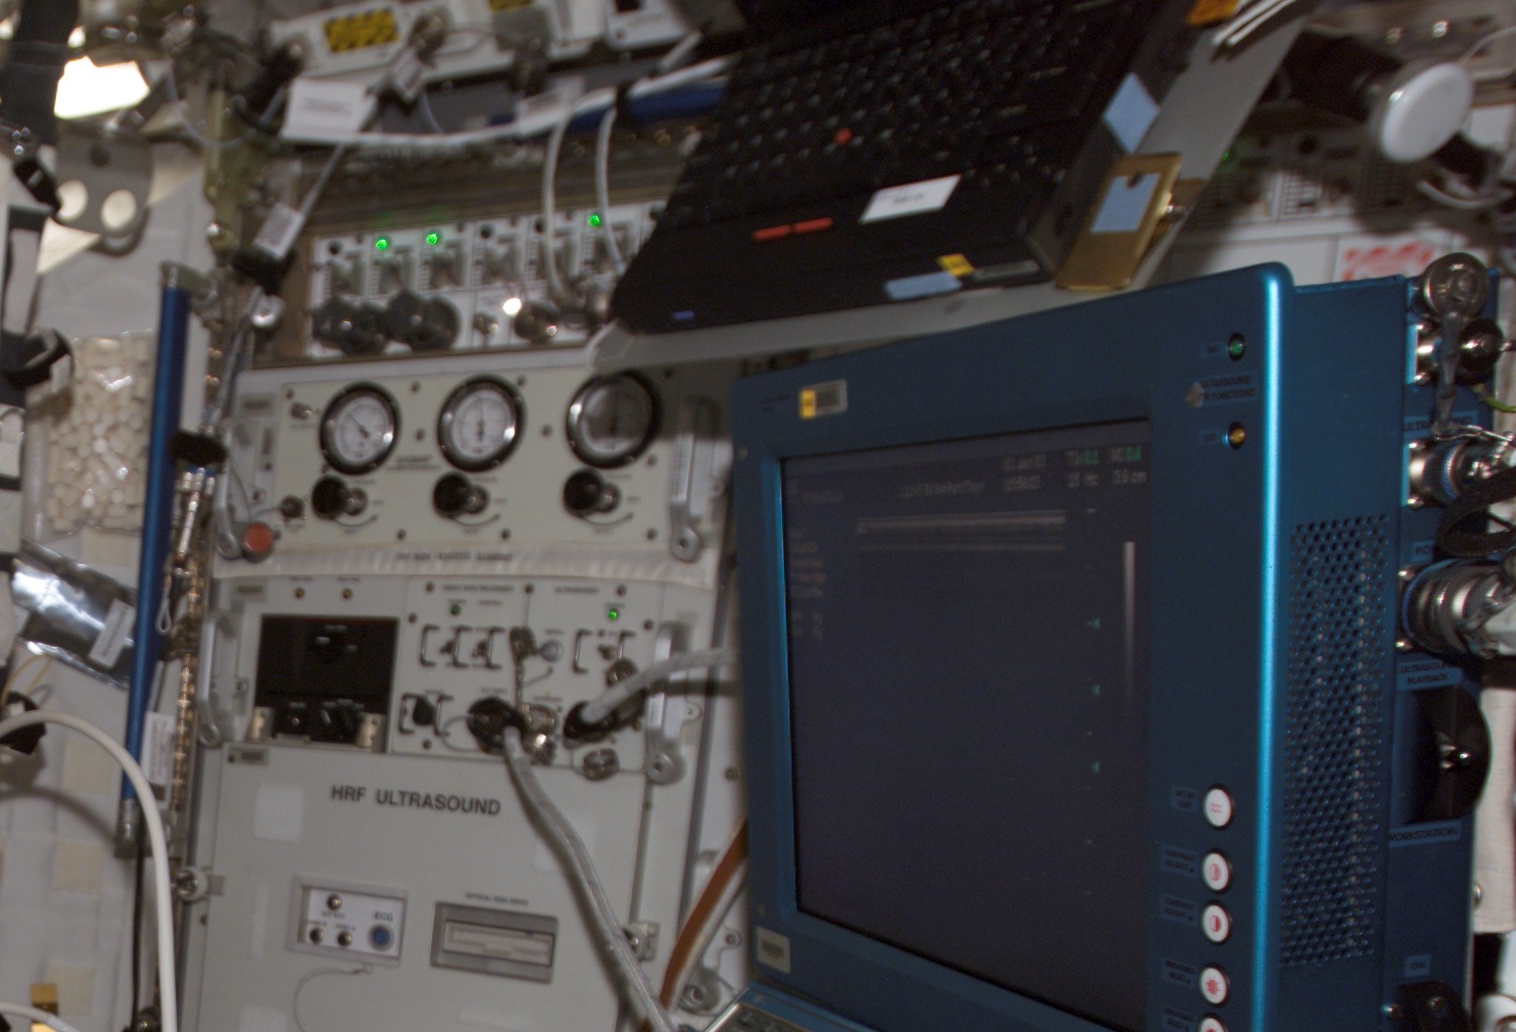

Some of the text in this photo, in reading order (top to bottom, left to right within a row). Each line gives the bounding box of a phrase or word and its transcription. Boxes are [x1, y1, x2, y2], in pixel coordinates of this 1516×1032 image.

[331, 785, 502, 816] HRF ULTRASOUND
[373, 911, 393, 922] ECG
